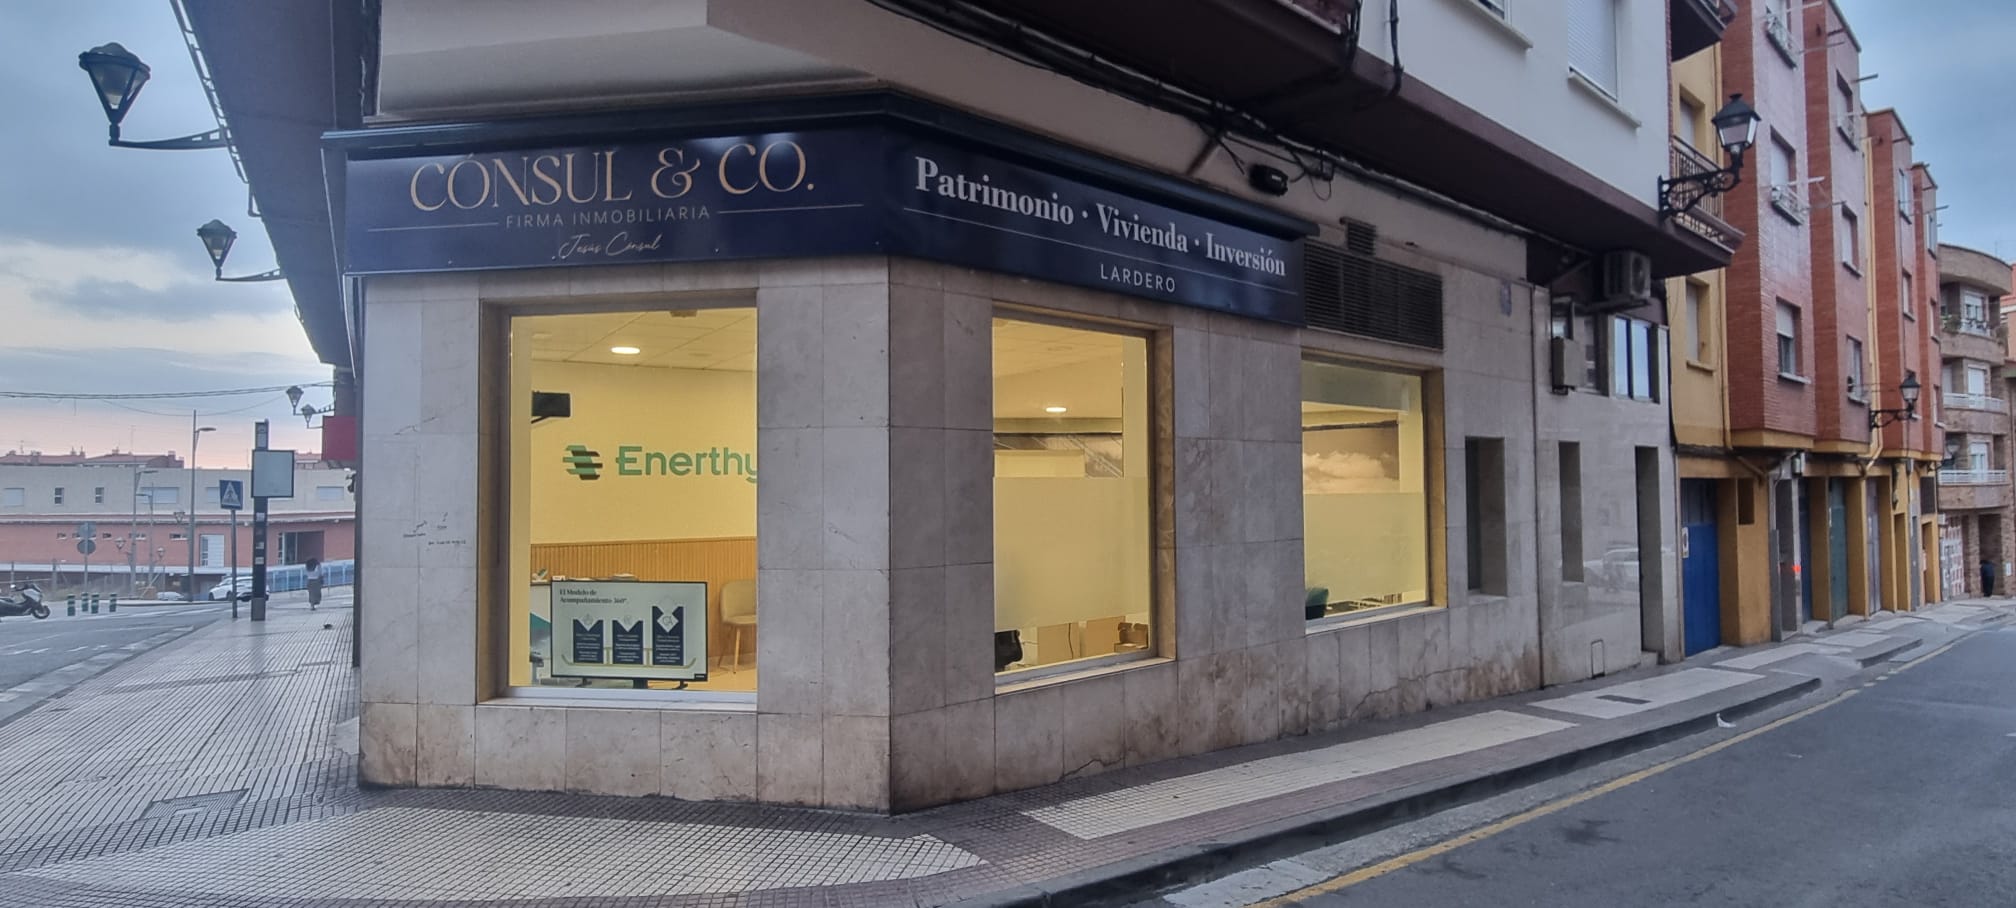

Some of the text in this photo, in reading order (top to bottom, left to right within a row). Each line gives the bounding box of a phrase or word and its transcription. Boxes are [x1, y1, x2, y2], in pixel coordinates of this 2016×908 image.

[409, 140, 815, 212] CÓNSUL & CO.
[505, 204, 710, 230] FIRMA INMOBILIARIA
[915, 156, 1074, 225] Patrimonio
[1096, 203, 1188, 254] Vivienda
[1206, 232, 1286, 277] Inversión
[1100, 263, 1176, 293] LARDERO
